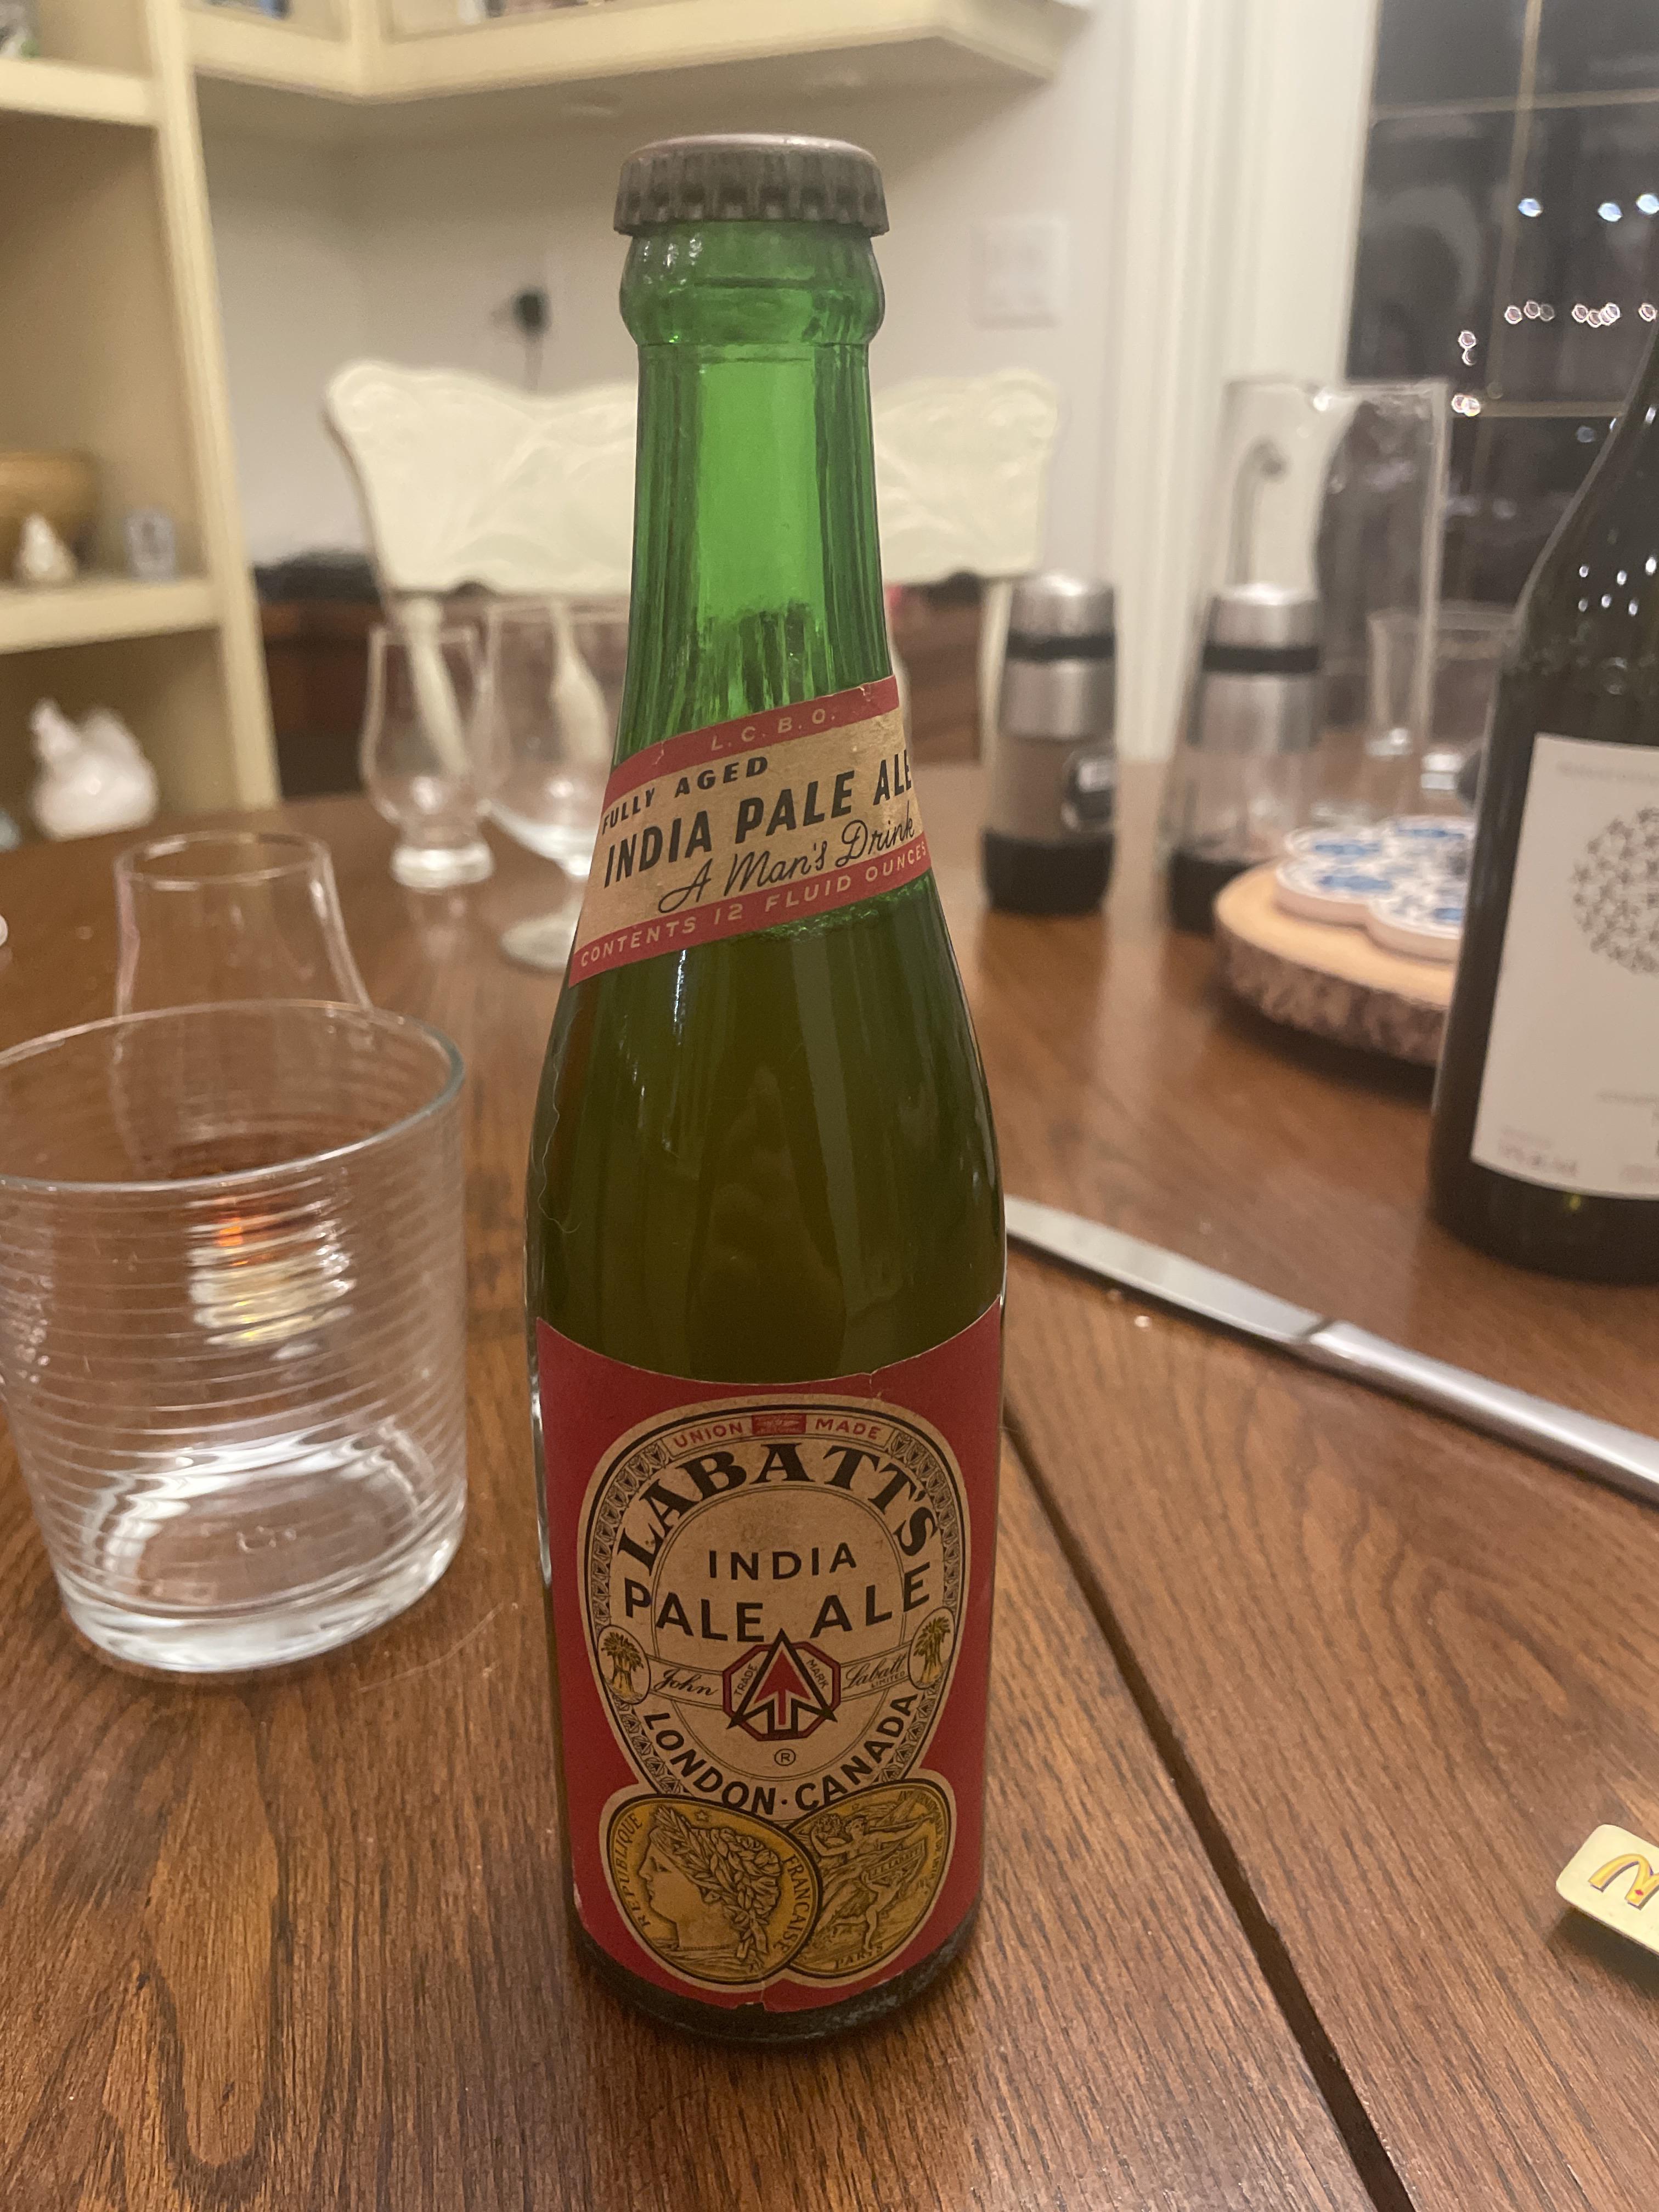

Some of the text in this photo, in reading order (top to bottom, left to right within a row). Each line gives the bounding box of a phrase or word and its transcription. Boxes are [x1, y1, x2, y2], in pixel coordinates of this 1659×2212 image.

[602, 757, 768, 836] FULLY AGED
[604, 749, 912, 888] INDIA PALE ALE
[658, 803, 915, 913] A Man's Drink
[580, 840, 927, 967] CONTENTS 12 FLUID OUNCES
[673, 1418, 882, 1448] UNION MADE
[617, 1443, 939, 1576] LABATT'S
[708, 1542, 857, 1581] INDIA
[624, 1561, 930, 1643] PALE ALE
[653, 1652, 908, 1696] John Labatt
[733, 1658, 830, 1696] TRADE MARK
[871, 1671, 905, 1688] LIMITED
